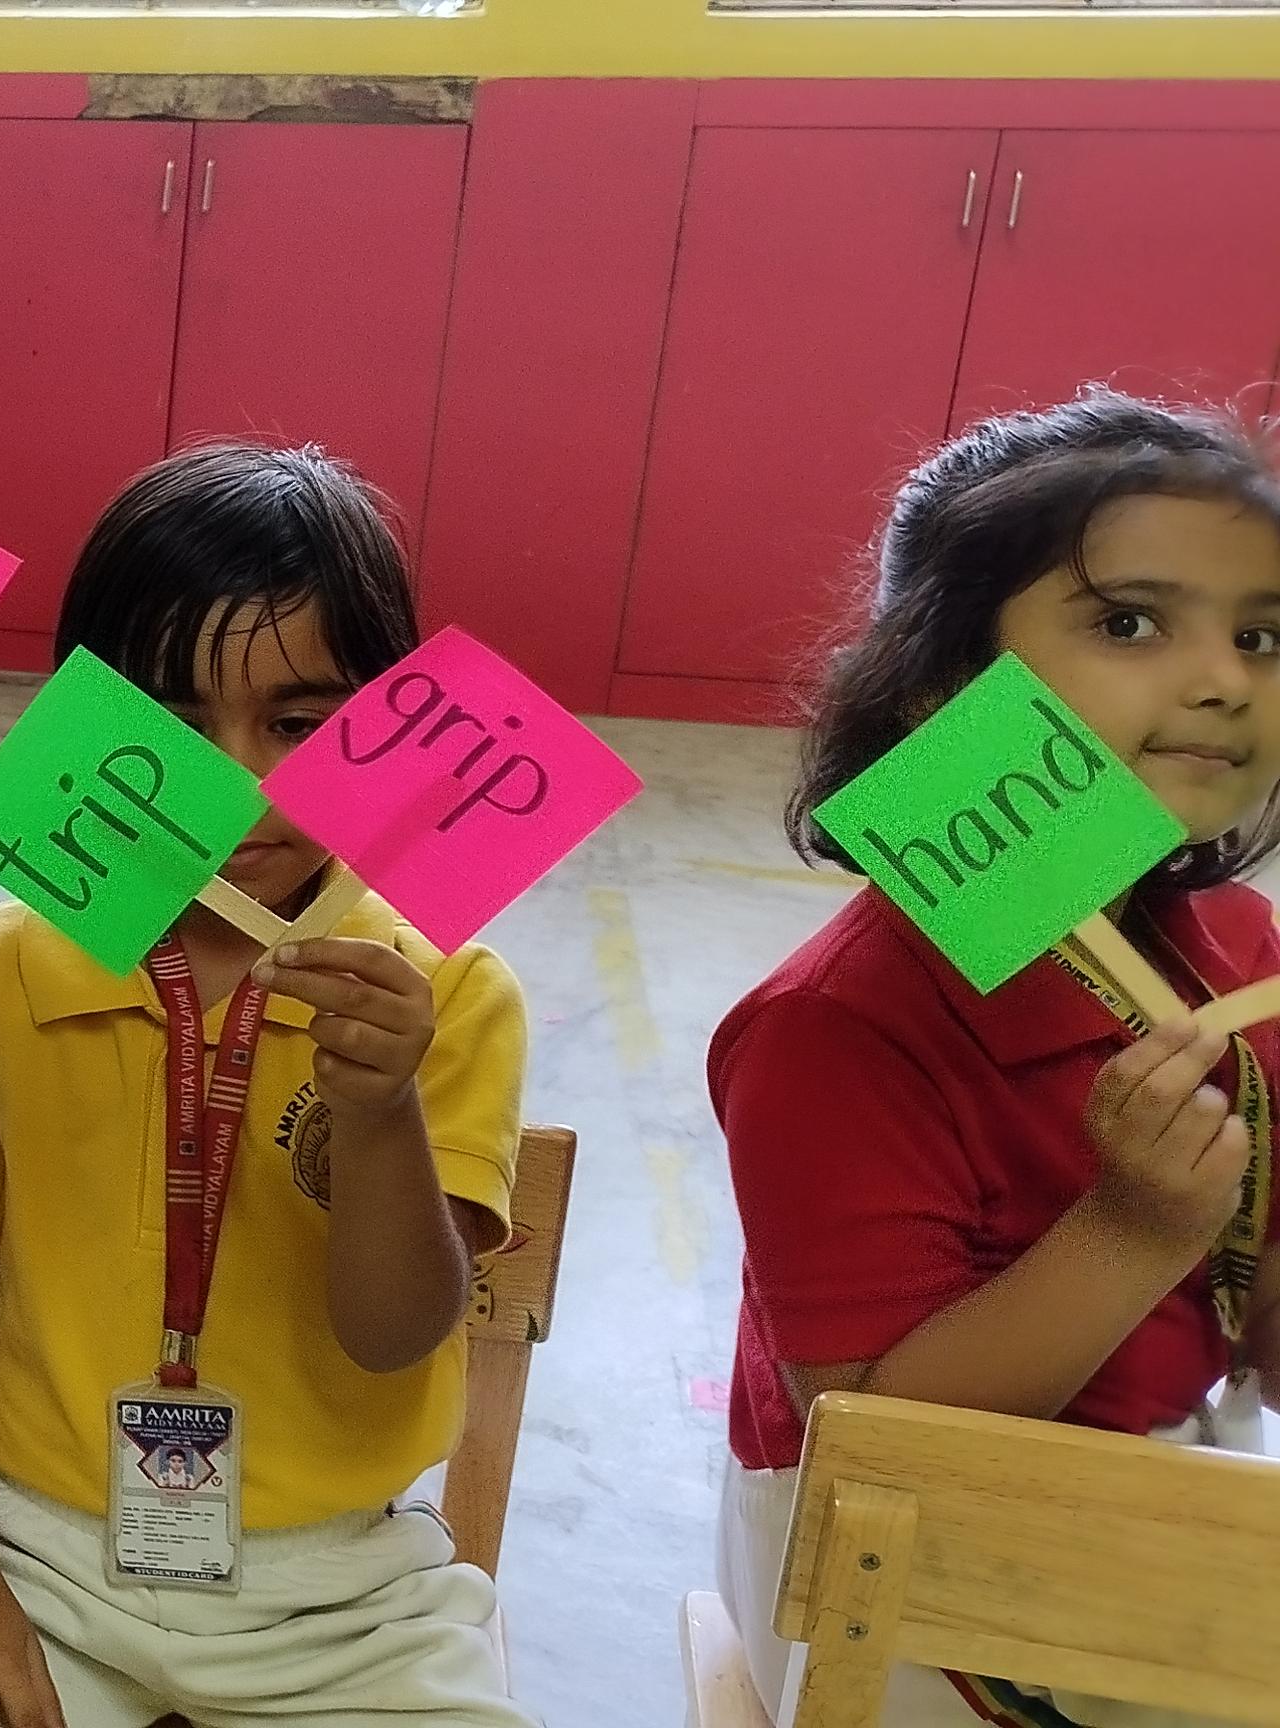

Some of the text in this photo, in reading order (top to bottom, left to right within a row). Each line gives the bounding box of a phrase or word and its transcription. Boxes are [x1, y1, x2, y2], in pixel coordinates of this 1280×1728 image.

[341, 671, 550, 832] grip
[862, 697, 1107, 909] hand
[237, 986, 263, 1046] AMRITA
[173, 986, 196, 1135] AMRITA VIDYALAYAM
[274, 1082, 316, 1150] AMRIT
[203, 1122, 234, 1219] VIDYALAYAM
[145, 1406, 227, 1424] AMRITA
[146, 1418, 227, 1430] VIDYALAYAM
[134, 1568, 176, 1577] STUDENT
